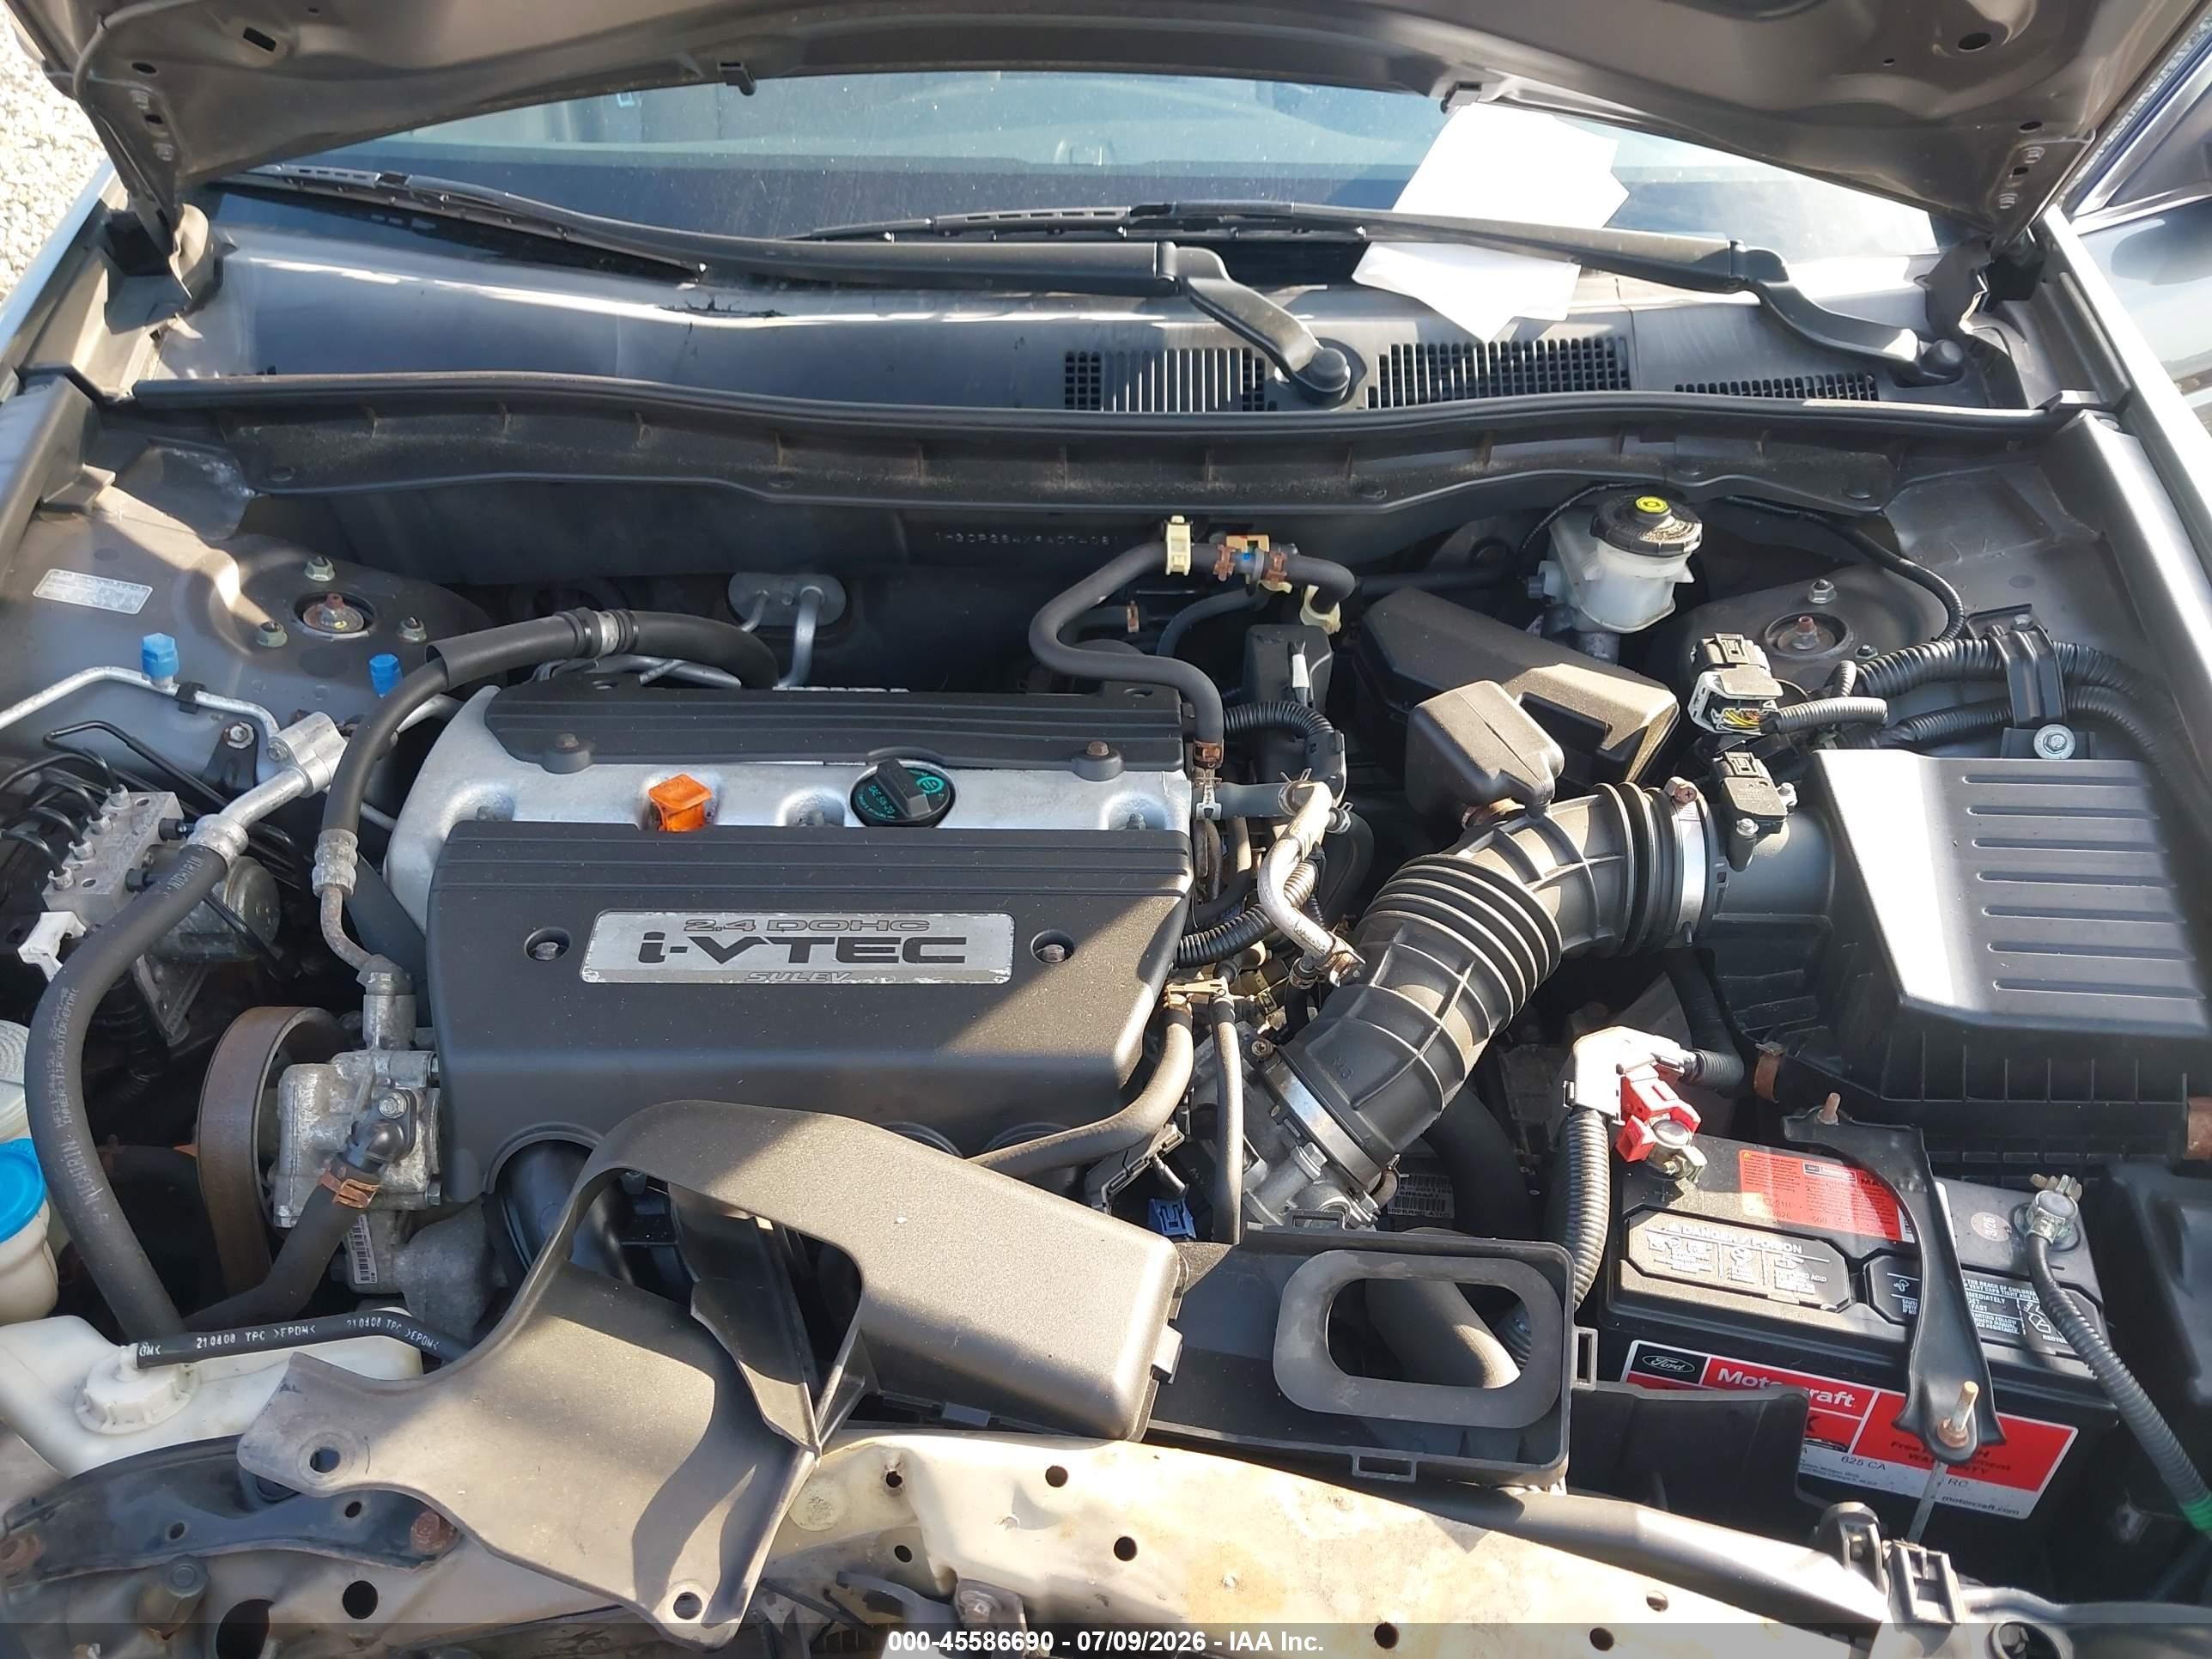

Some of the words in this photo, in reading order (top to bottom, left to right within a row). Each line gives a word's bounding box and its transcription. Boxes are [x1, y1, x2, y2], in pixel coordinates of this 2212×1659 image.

[684, 920, 756, 932] 2.4
[767, 920, 929, 933] DOHC
[638, 932, 967, 964] i-VTEC
[745, 971, 851, 982] SULEV
[246, 1331, 265, 1343] TPC
[1650, 1357, 1686, 1371] Ford
[1840, 1455, 1864, 1467] 625
[1868, 1460, 1887, 1471] CA
[1948, 1477, 1969, 1487] RC
[1942, 1496, 2020, 1516] motorcraft.com
